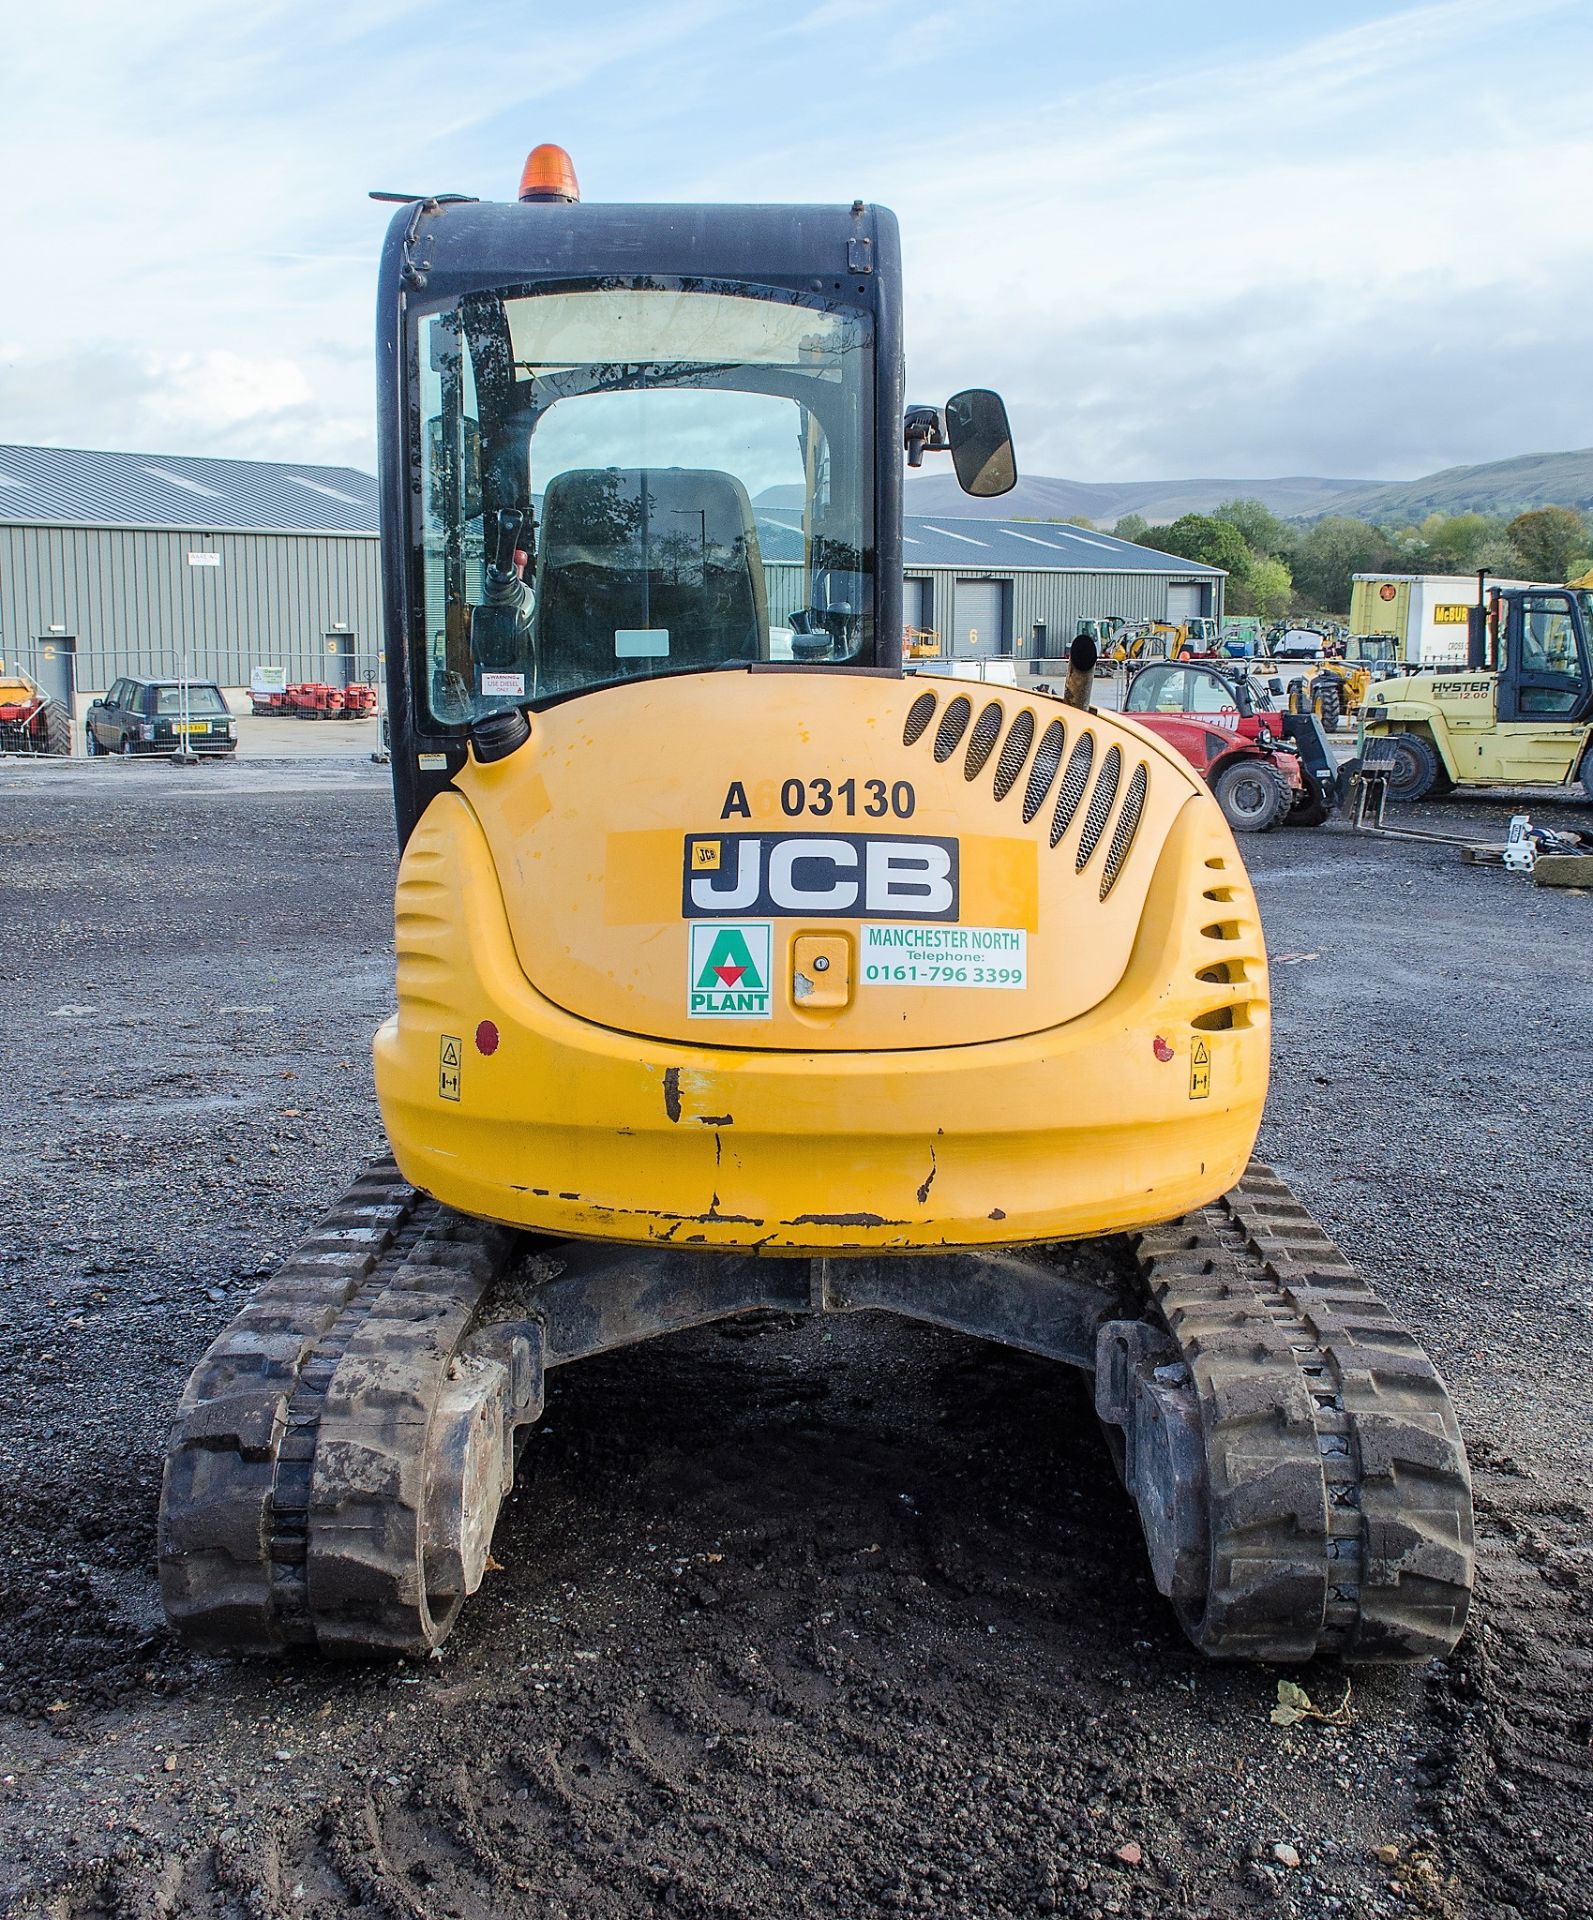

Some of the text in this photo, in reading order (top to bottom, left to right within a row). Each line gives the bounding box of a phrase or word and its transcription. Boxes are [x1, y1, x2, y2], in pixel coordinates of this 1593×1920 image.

[969, 628, 978, 644] 6
[327, 641, 337, 653] 3
[1431, 682, 1490, 692] HYSTER
[720, 778, 916, 819] A 03130
[699, 848, 716, 862] JCB
[690, 839, 954, 913] JCB
[869, 928, 1020, 950] MANCHESTER NORTH
[906, 950, 985, 963] Telephone:
[866, 965, 1022, 984] 0161-796 3399
[691, 994, 769, 1011] PLANT
